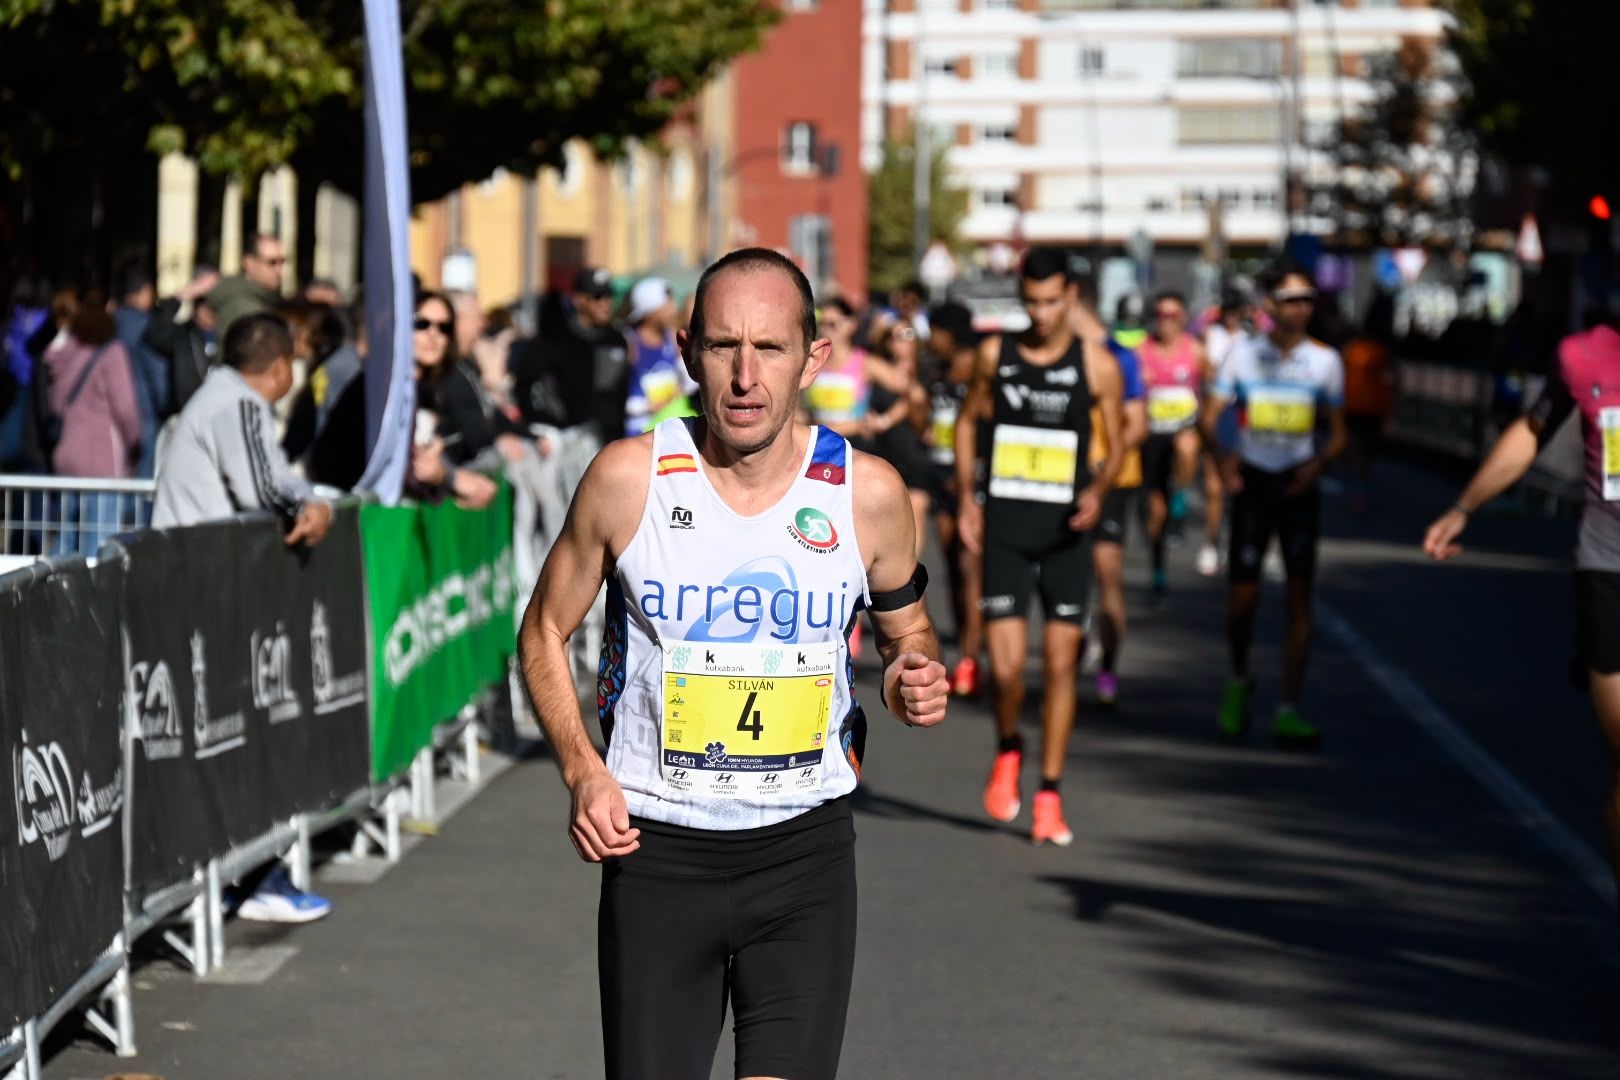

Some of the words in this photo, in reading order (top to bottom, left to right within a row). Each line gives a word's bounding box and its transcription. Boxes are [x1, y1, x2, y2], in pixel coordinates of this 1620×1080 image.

[786, 525, 798, 540] CLUB
[797, 539, 827, 554] ATLETISMO
[640, 579, 848, 640] arregui
[705, 663, 745, 673] kutxabank
[796, 663, 832, 673] kutxabank
[728, 678, 774, 691] SILVÁN
[736, 692, 764, 741] 4
[667, 778, 693, 787] HYUNDAI
